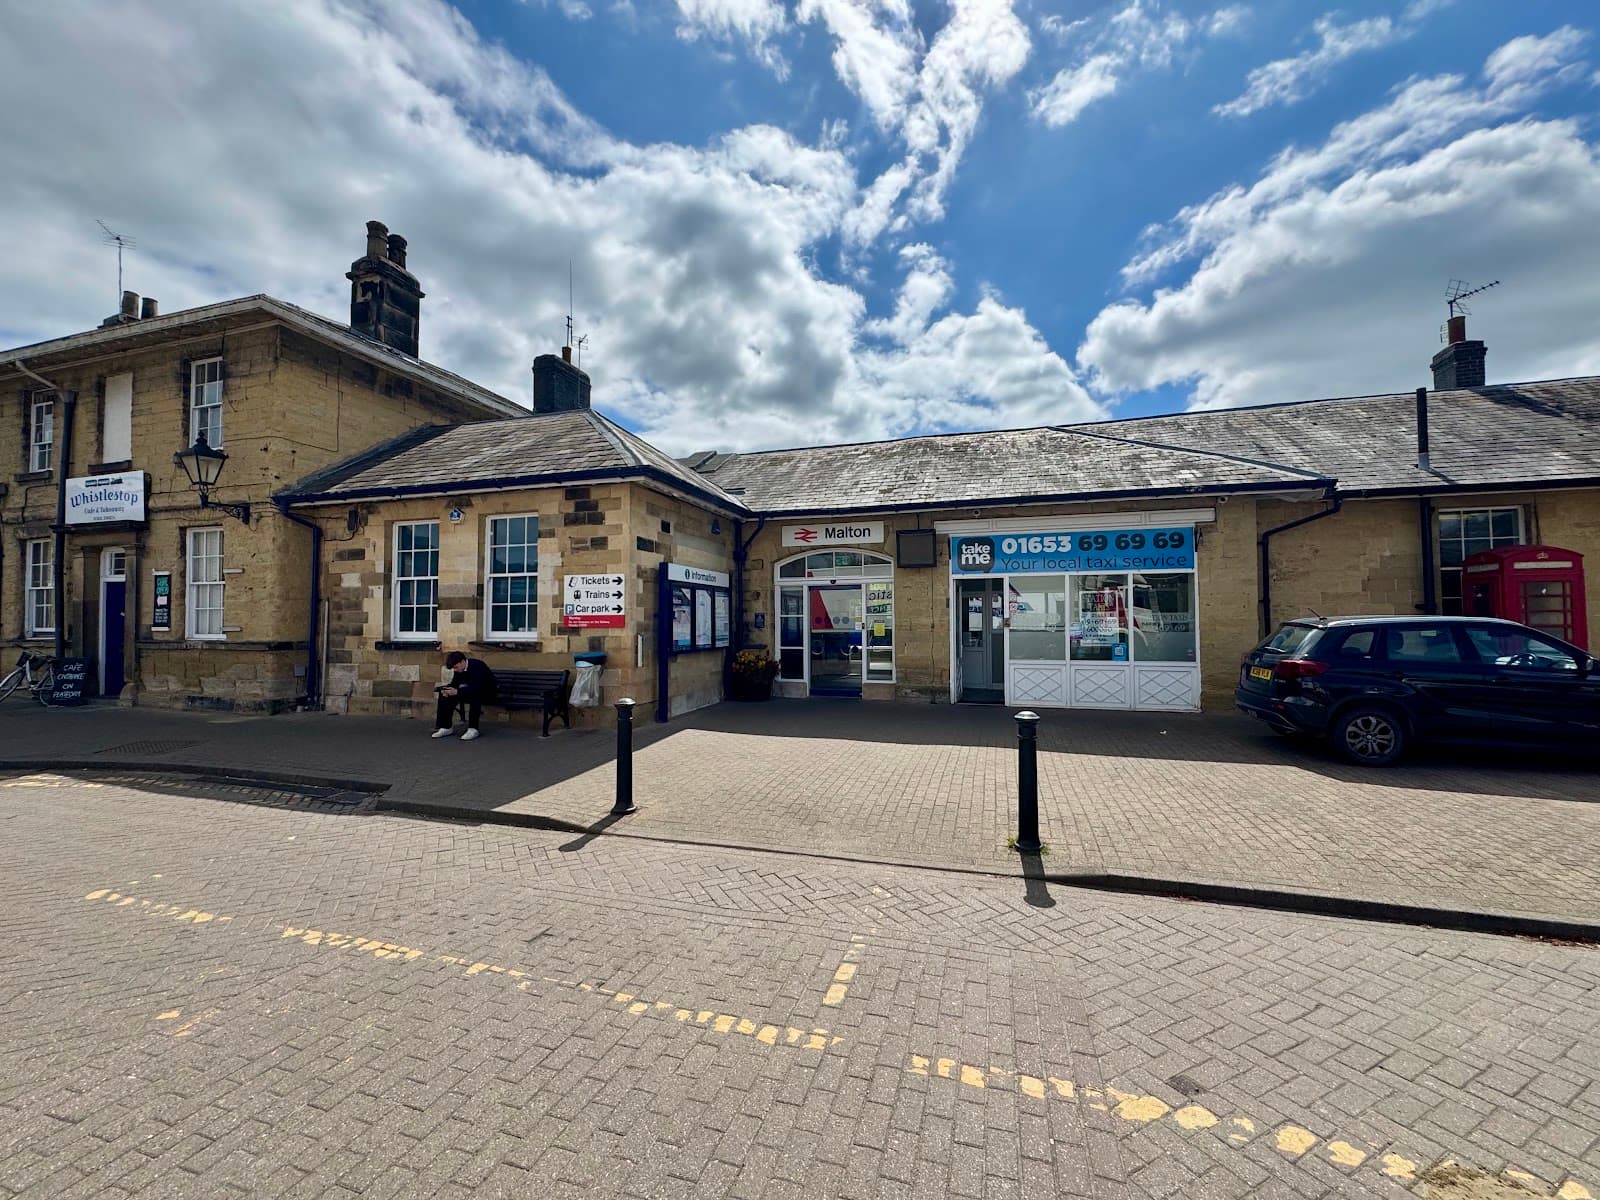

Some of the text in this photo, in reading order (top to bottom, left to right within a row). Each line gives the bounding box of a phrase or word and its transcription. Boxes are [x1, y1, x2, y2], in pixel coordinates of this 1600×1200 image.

[70, 488, 139, 507] Whistlestop
[825, 526, 871, 539] Malton
[961, 542, 990, 554] take
[1001, 531, 1185, 554] 01653 69 69 69
[961, 553, 991, 565] me
[1001, 554, 1187, 570] Your local taxi service
[580, 576, 610, 585] Tickets
[692, 571, 717, 583] Information
[585, 590, 610, 599] Trains
[575, 604, 590, 613] Car
[591, 604, 610, 613] park
